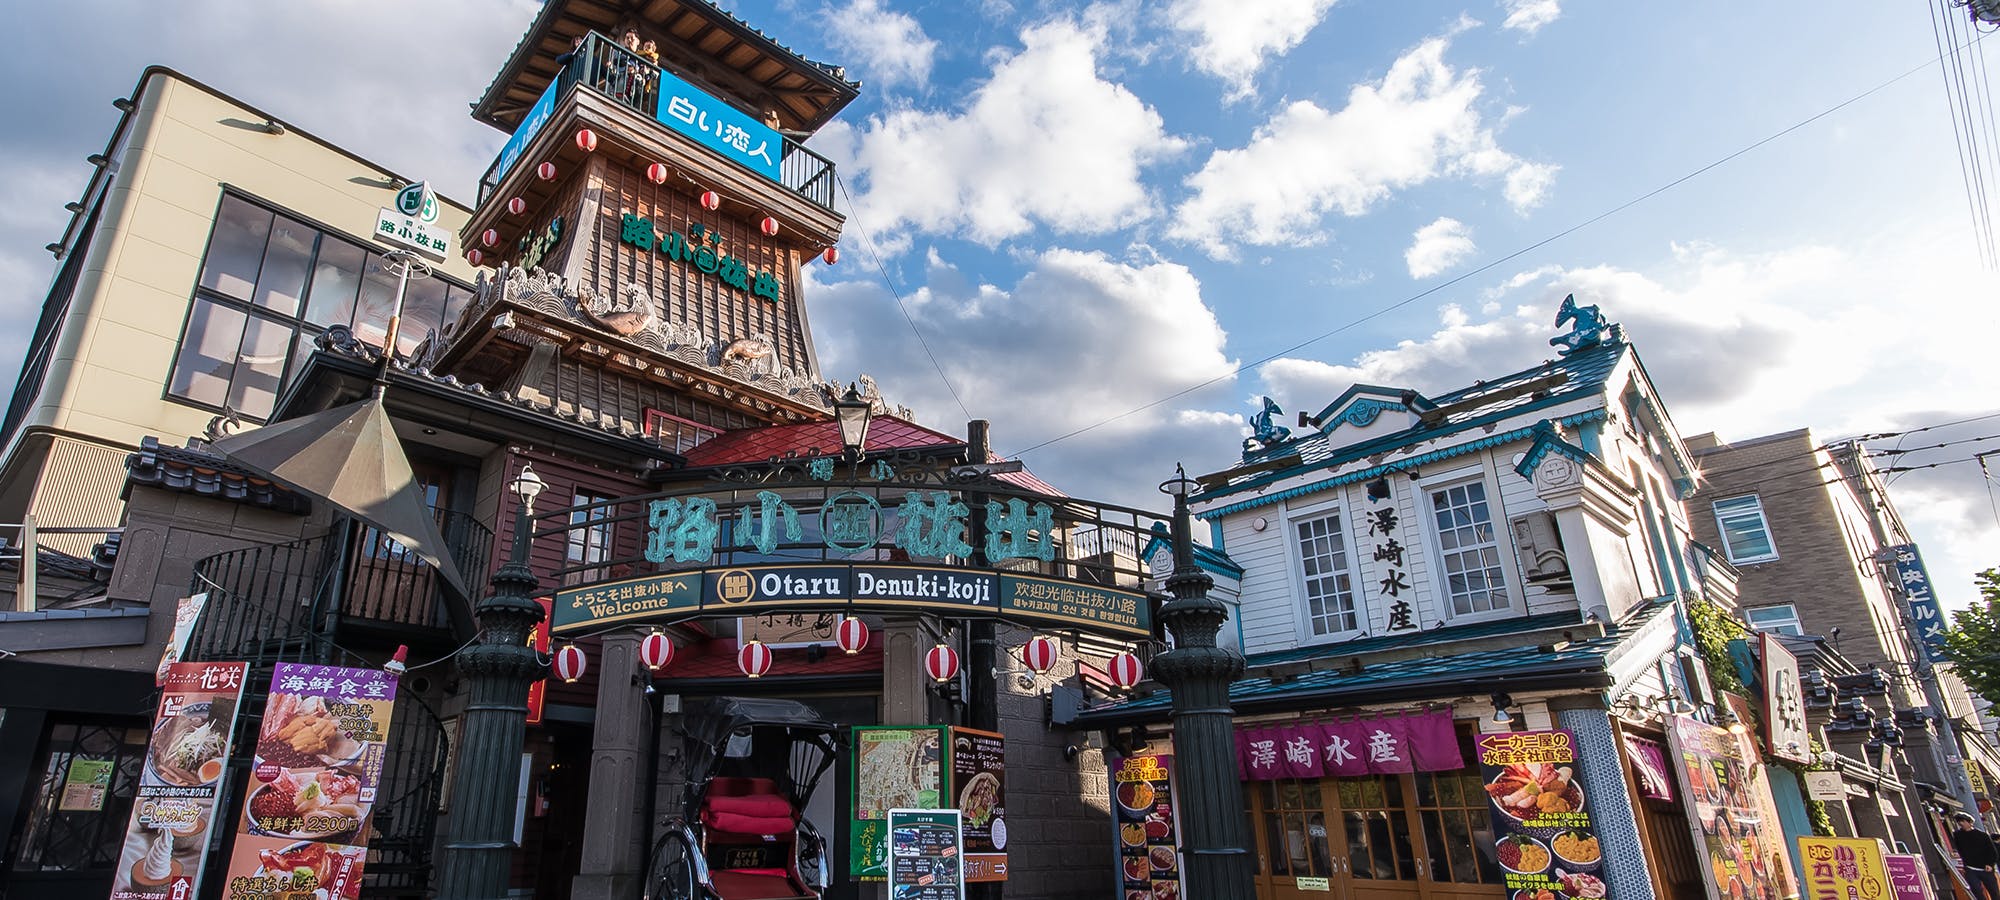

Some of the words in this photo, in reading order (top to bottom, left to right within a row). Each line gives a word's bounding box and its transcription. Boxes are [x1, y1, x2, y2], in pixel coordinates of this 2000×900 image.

[501, 101, 550, 175] 白い恋人
[668, 95, 773, 167] 白い恋人
[1366, 506, 1419, 634] 澤崎水産
[571, 580, 688, 609] ようこそ出抜小路へ
[760, 572, 841, 597] Otaru
[857, 572, 991, 605] Denuki-koji
[589, 597, 669, 619] Welcome
[1061, 604, 1078, 616] 오신
[1080, 607, 1096, 618] 것을
[170, 672, 199, 680] ラーメン
[280, 675, 389, 698] 海鮮食堂
[1250, 729, 1401, 770] 澤崎水産
[1510, 732, 1569, 749] カニ屋の
[1123, 757, 1159, 770] カニ屋の
[1482, 747, 1573, 765] 水産会社直営
[1115, 767, 1169, 782] 水産会社直営
[258, 817, 304, 830] 海鮮丼
[1809, 846, 1832, 861] BIG
[1833, 845, 1859, 882] 小樽
[231, 876, 319, 892] 特選ちらし丼
